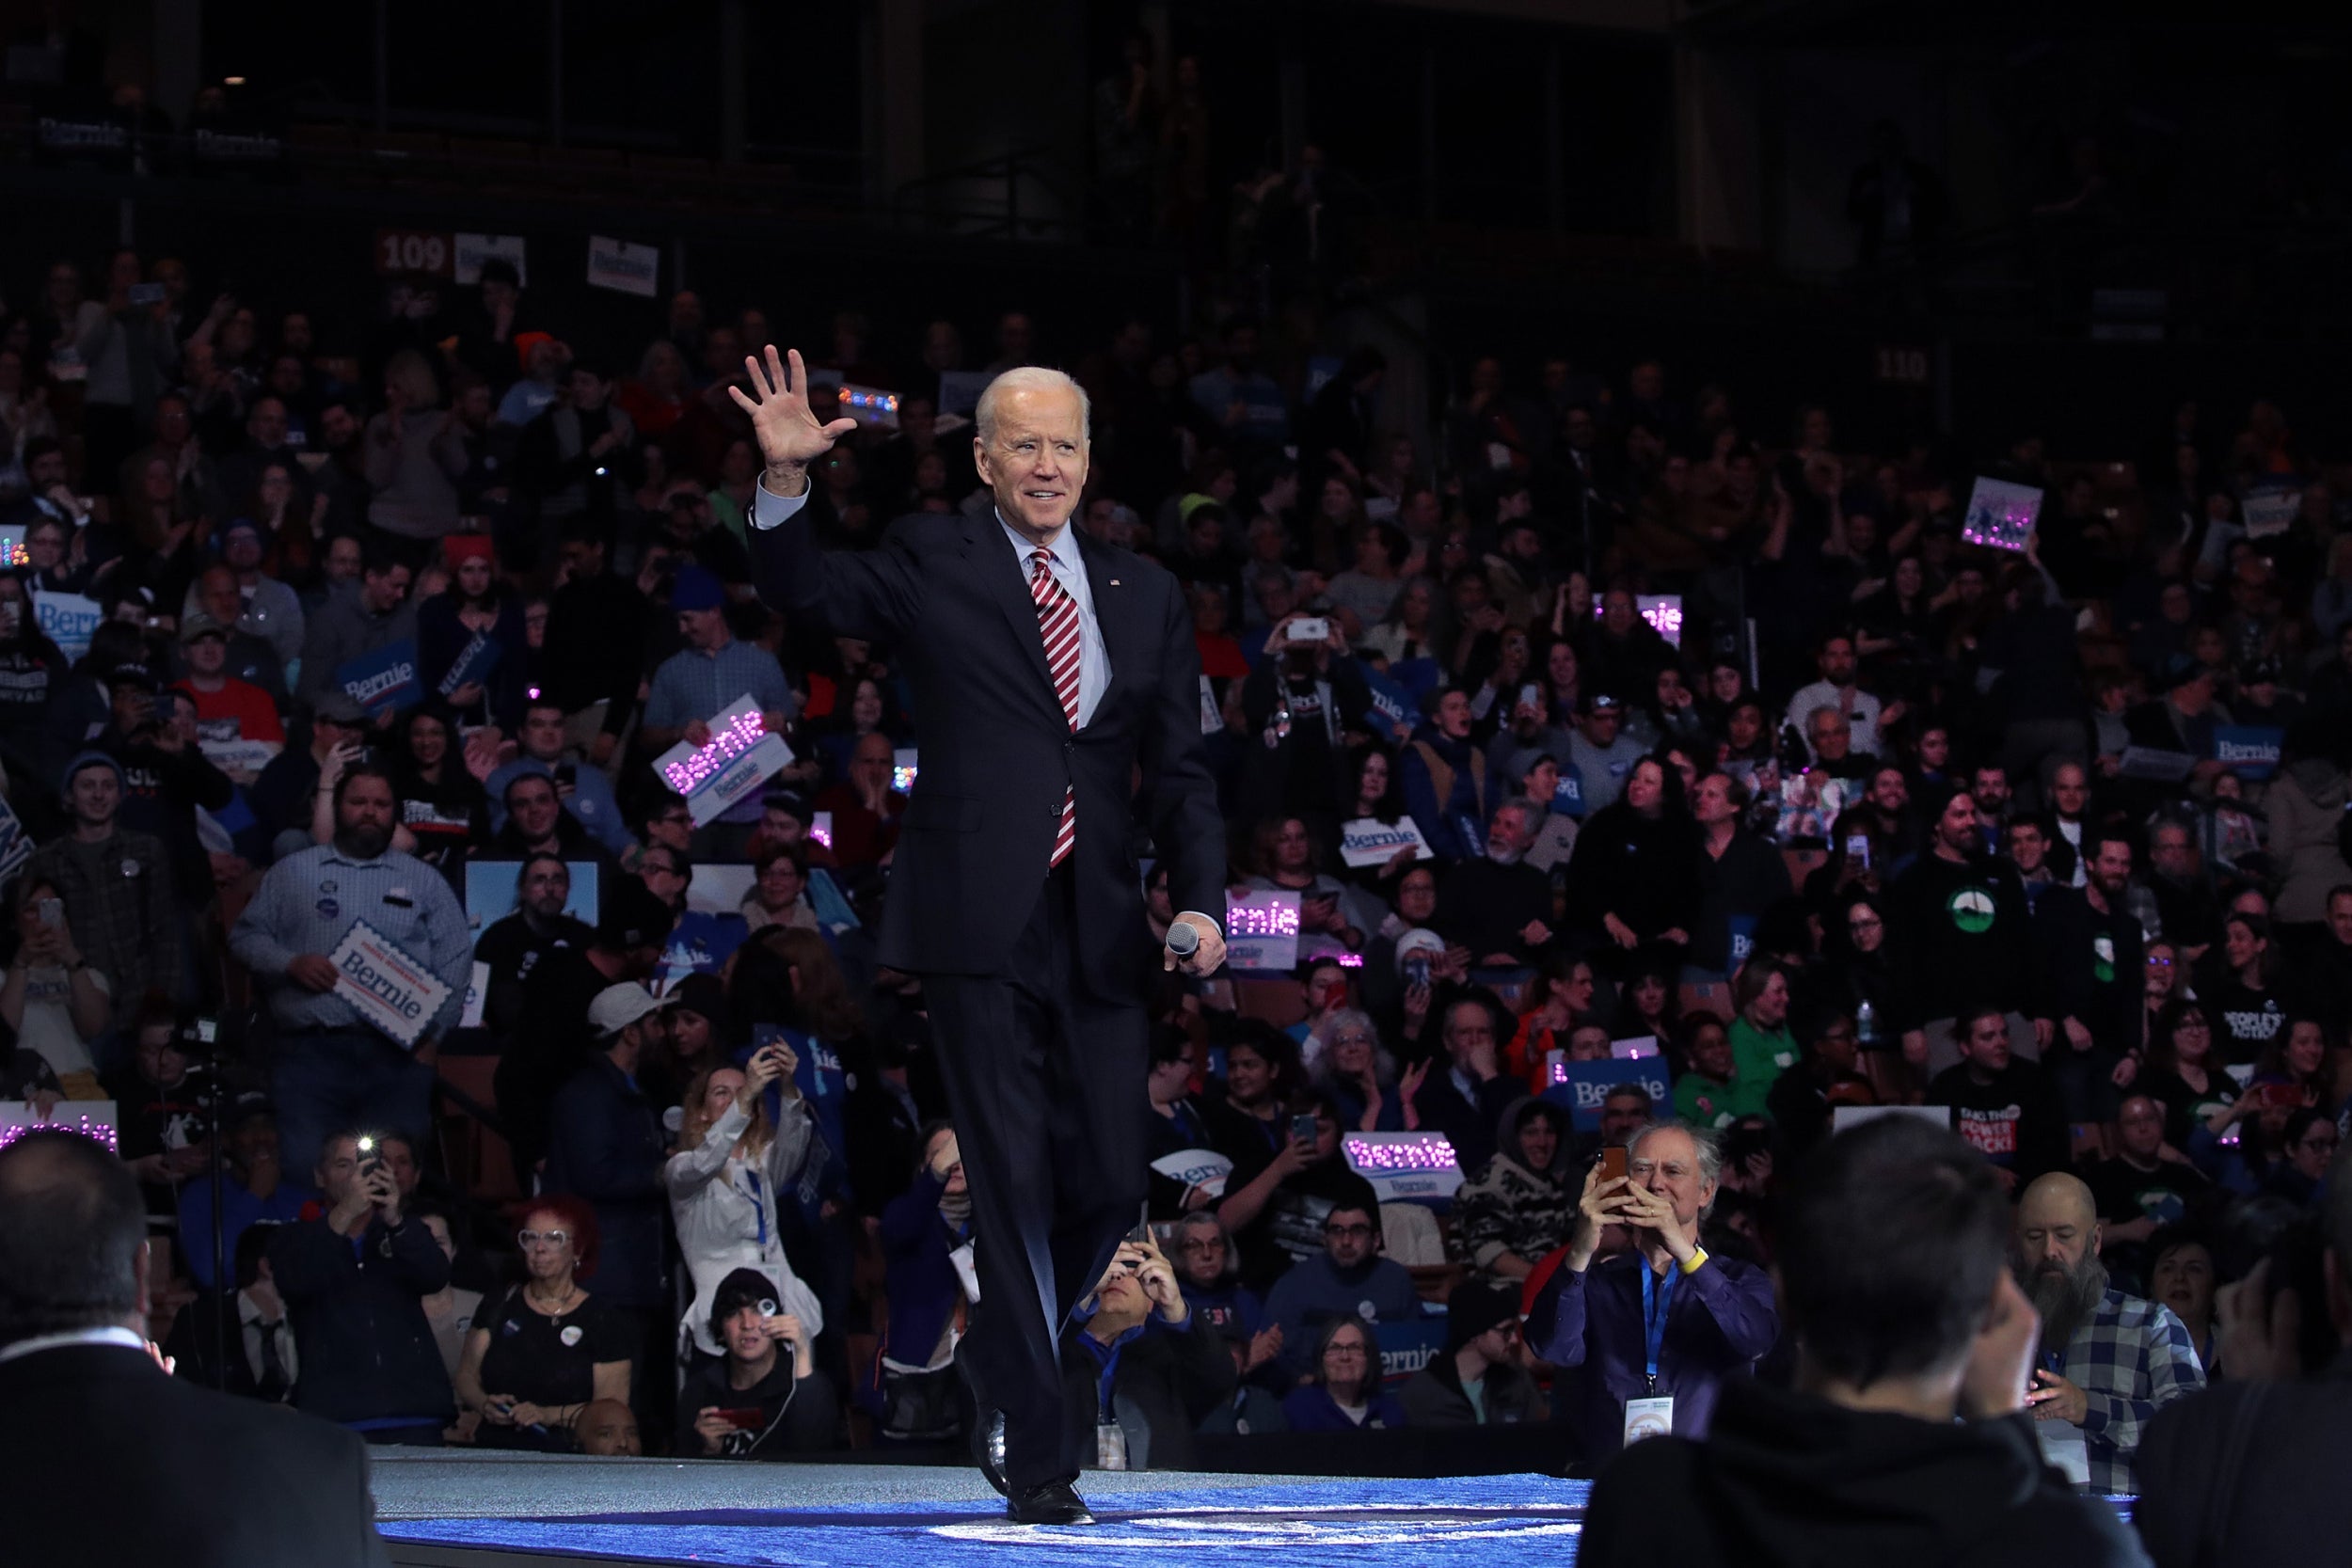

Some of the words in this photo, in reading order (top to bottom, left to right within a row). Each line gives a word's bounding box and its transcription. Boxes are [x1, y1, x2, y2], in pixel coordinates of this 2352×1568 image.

[383, 235, 445, 270] 109
[344, 661, 414, 704] Bernie
[665, 710, 764, 795] Bernie
[2218, 740, 2280, 761] Bernie
[1343, 832, 1418, 847] Bernie
[342, 950, 421, 1020] Bernie
[1348, 1137, 1455, 1168] Bernie
